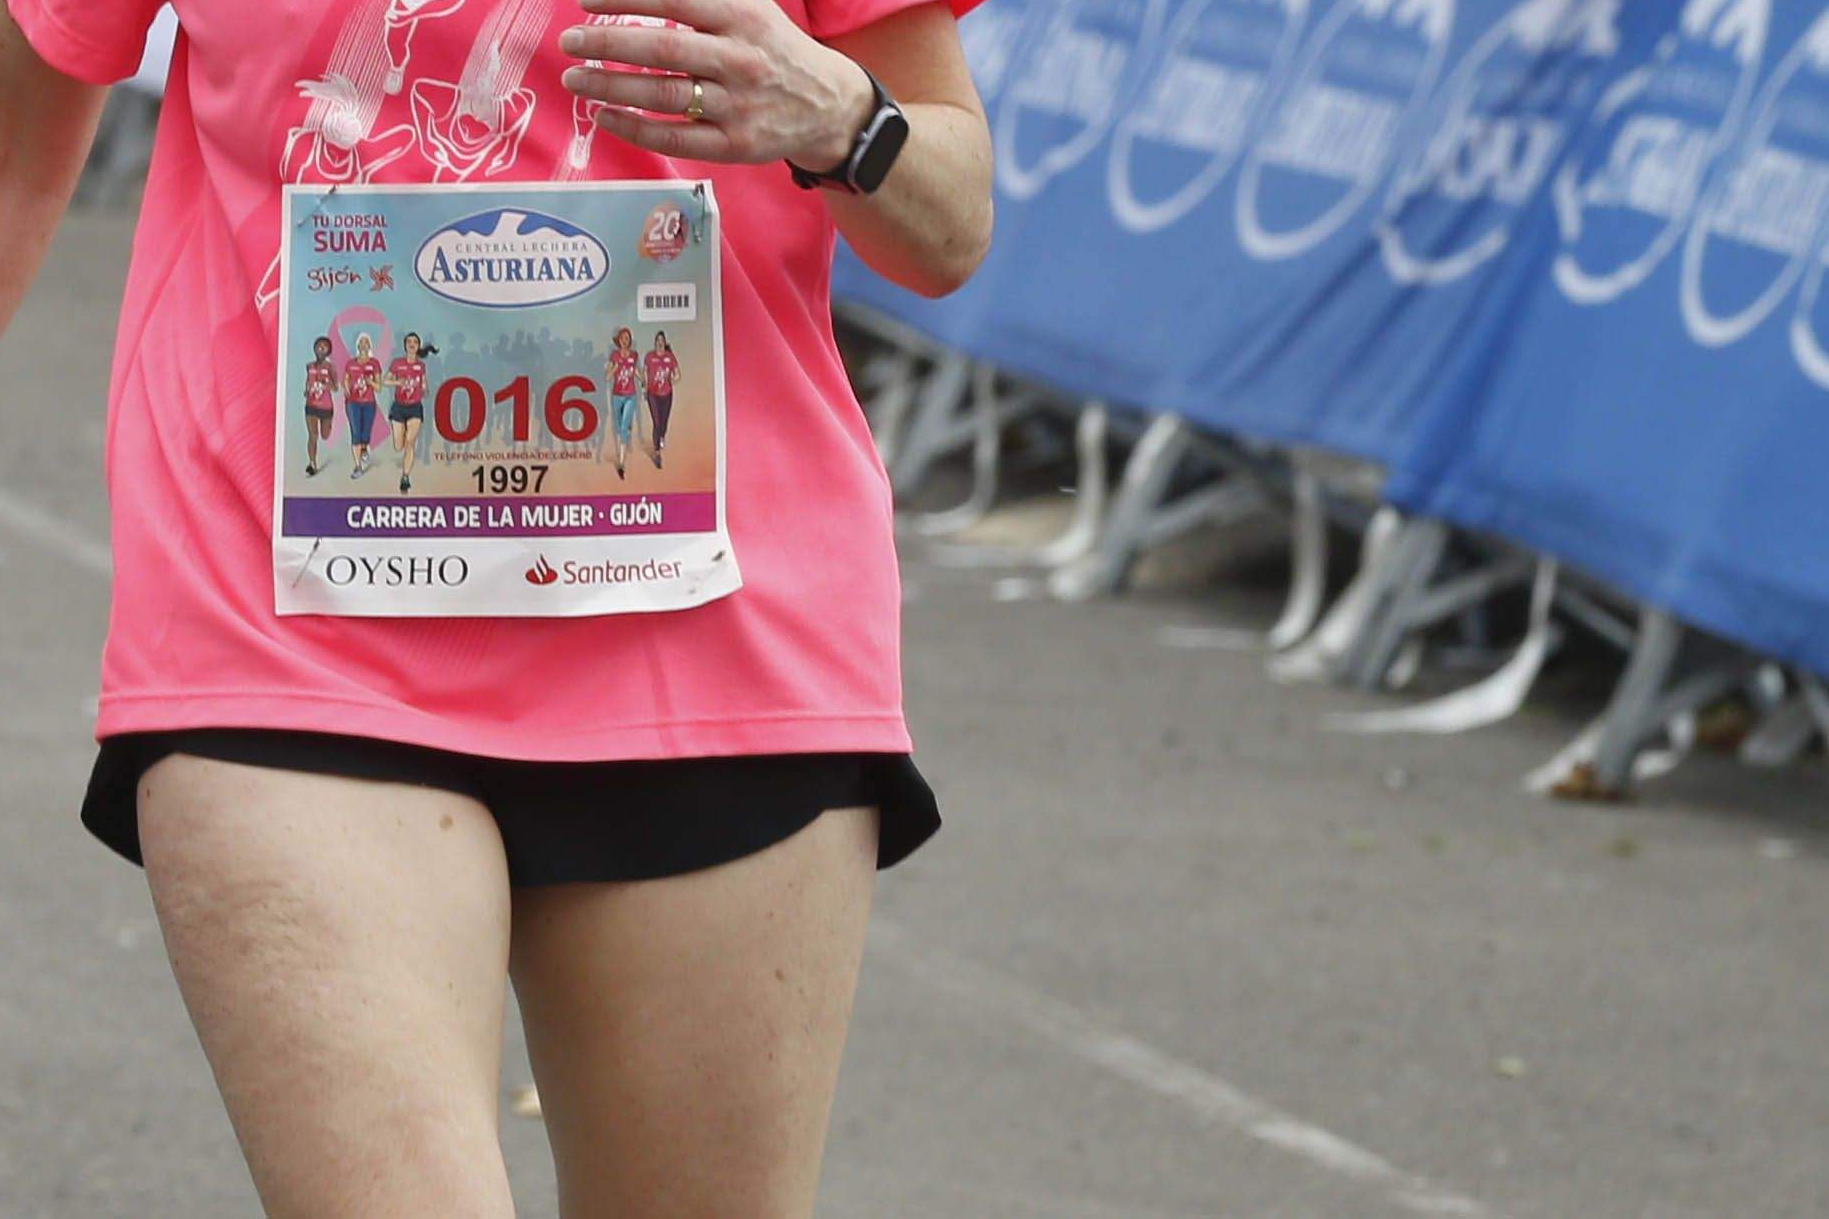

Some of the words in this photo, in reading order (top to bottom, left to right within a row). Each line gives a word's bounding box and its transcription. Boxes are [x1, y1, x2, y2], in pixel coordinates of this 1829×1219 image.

[313, 214, 330, 229] TU
[334, 214, 388, 229] DORSAL
[313, 230, 387, 253] SUMA
[455, 242, 516, 254] CENTRAL
[523, 241, 589, 252] LECHERA
[428, 245, 596, 283] ASTURIANA
[434, 375, 599, 443] 016
[472, 465, 549, 494] 1997
[347, 505, 447, 529] CARRERA
[454, 505, 481, 528] DE
[488, 505, 515, 528] LA
[522, 504, 593, 527] MUJER
[610, 497, 663, 526] GIJÓN
[326, 555, 469, 587] OYSHO
[563, 559, 683, 585] Santander
